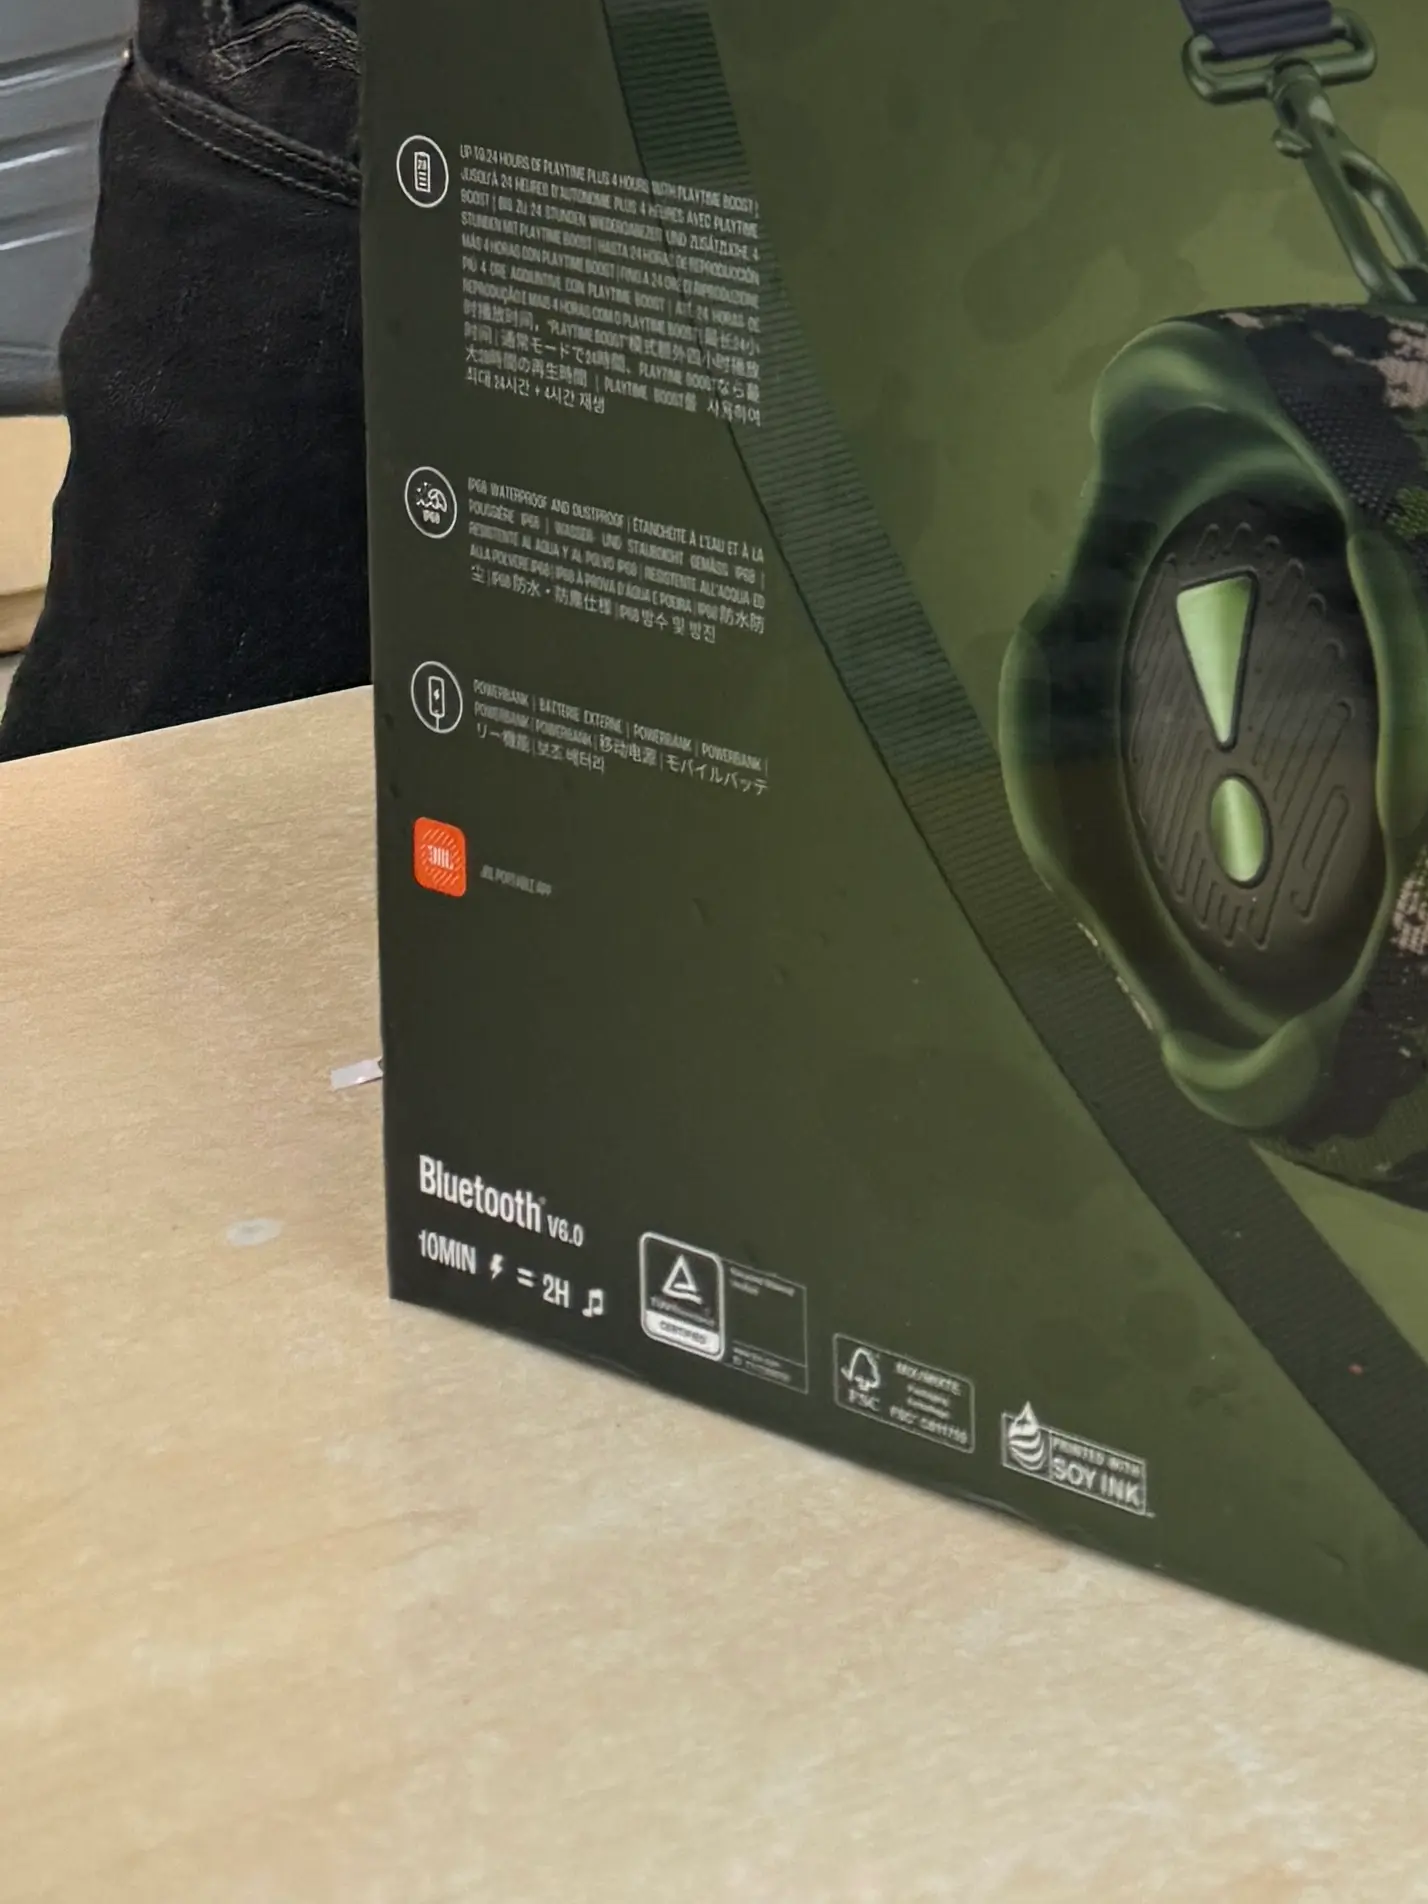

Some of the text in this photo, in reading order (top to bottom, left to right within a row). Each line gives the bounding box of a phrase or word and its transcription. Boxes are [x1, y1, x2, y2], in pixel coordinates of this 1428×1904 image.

[418, 1153, 541, 1233] Bluetooth
[418, 1226, 476, 1276] 10MIN
[542, 1271, 570, 1309] 2H
[1053, 1455, 1140, 1508] SOY INK
